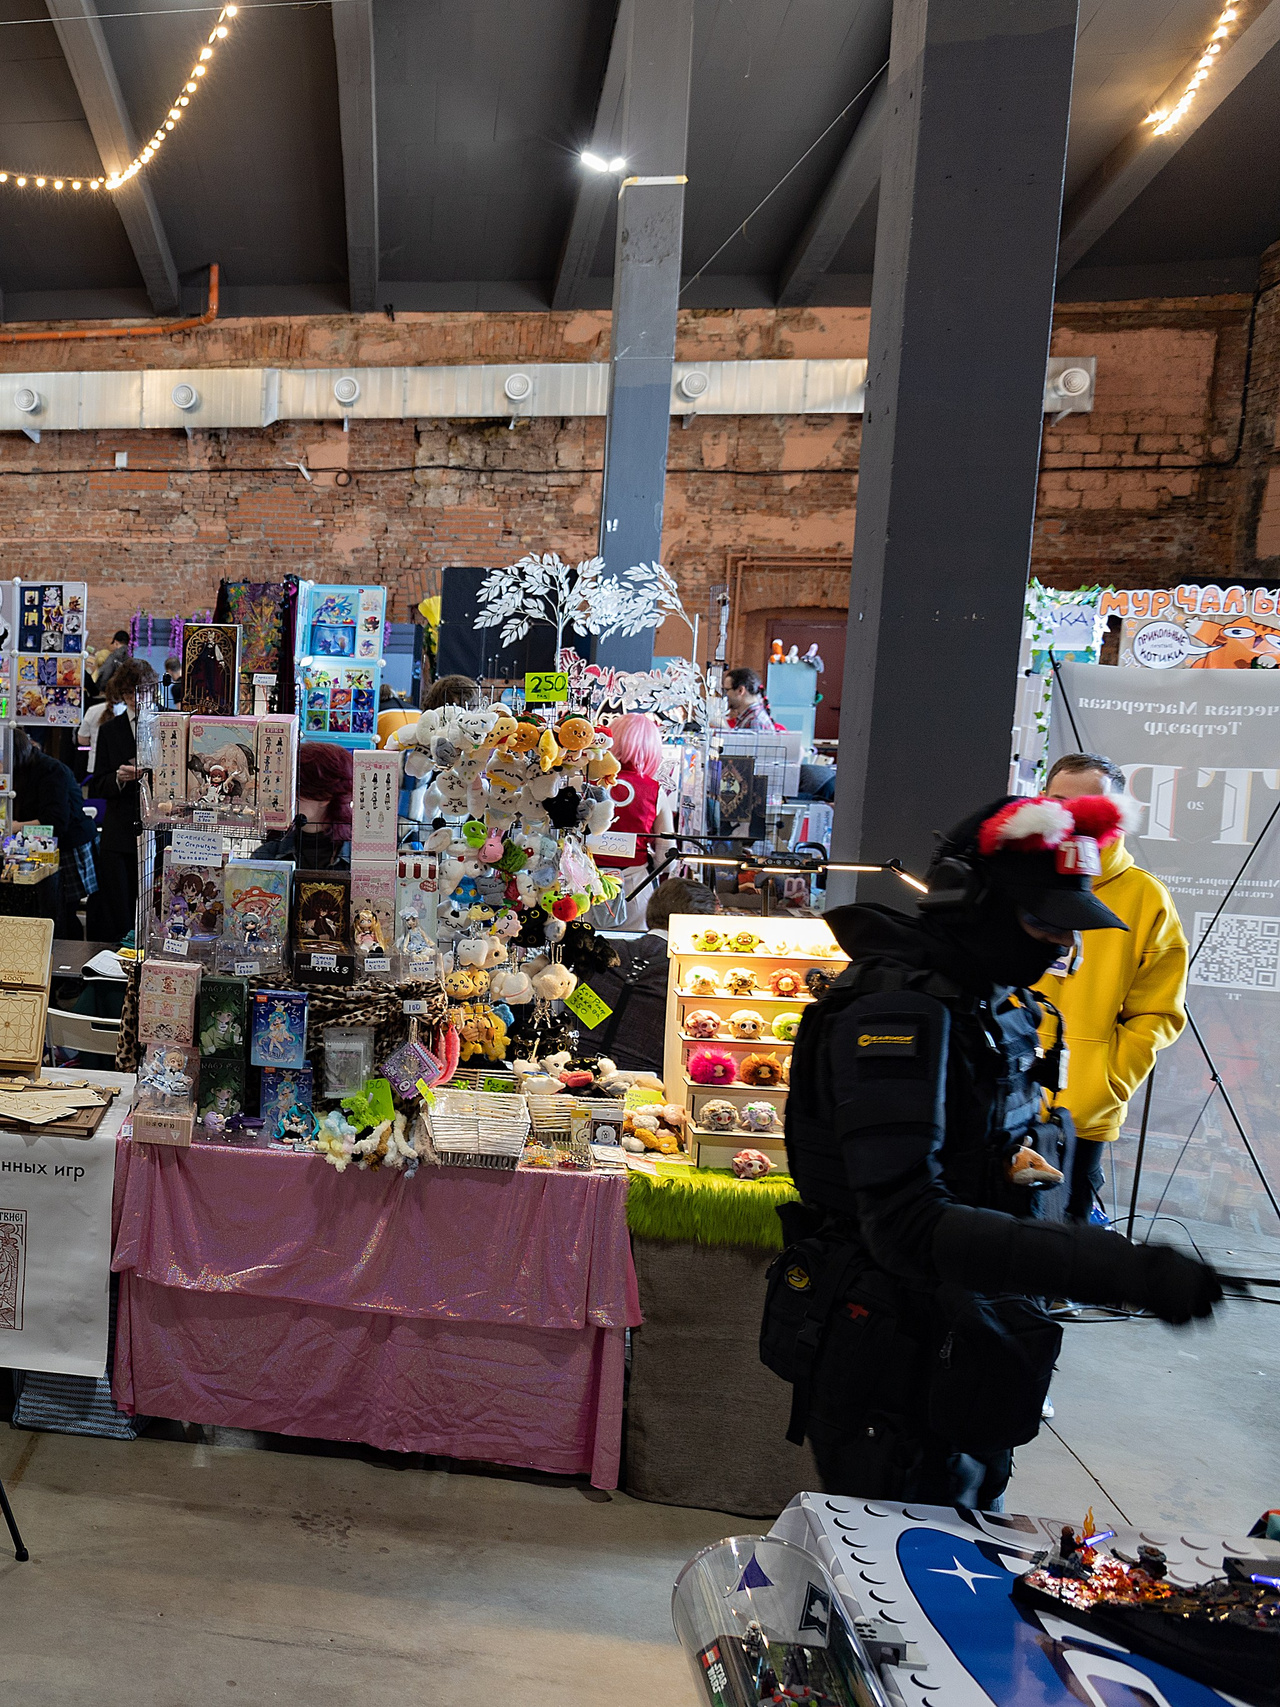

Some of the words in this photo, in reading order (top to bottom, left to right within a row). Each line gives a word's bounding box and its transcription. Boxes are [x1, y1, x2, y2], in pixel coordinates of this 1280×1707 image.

[1138, 627, 1188, 648] ПРИКОЛЬНЫЕ
[1140, 649, 1184, 663] КОТИКИ
[530, 675, 566, 693] 250
[54, 1164, 86, 1183] игр
[707, 1666, 722, 1694] WARS
[715, 1663, 728, 1690] STAR
